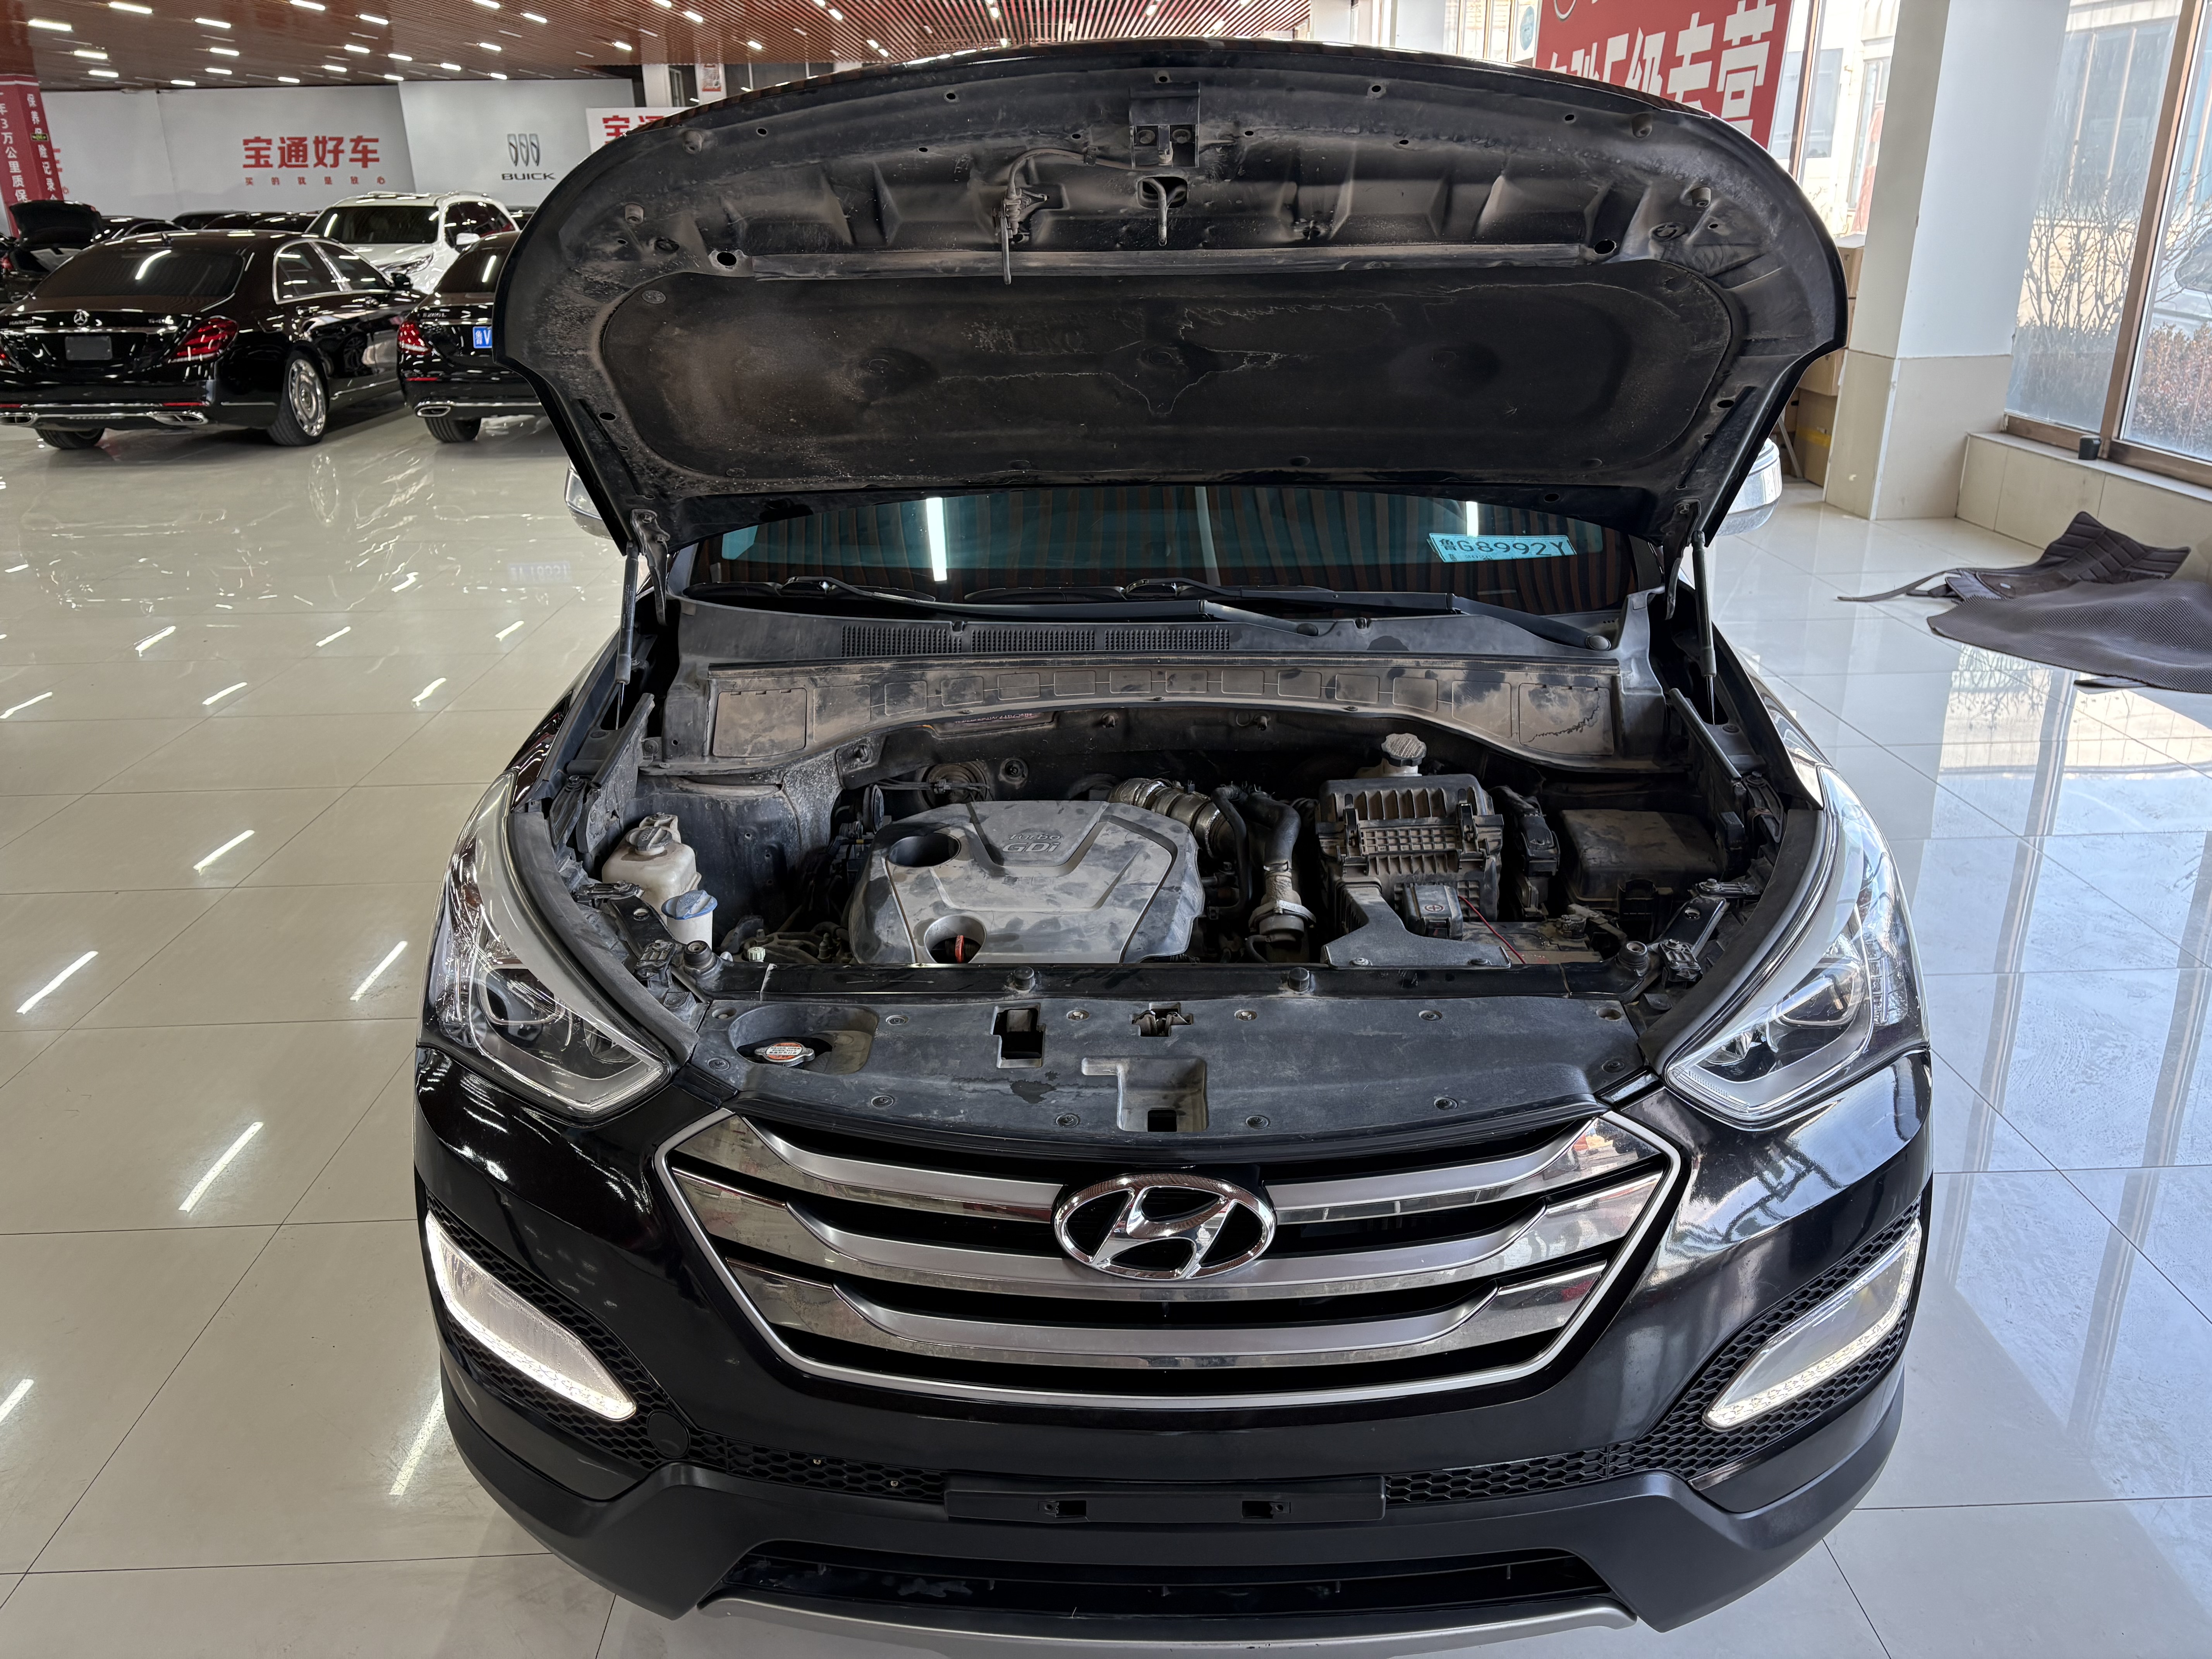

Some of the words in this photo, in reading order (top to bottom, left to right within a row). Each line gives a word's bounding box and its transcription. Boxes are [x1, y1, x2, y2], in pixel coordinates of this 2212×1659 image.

[242, 135, 380, 169] 宝通好车
[1439, 538, 1566, 556] 鲁G8992Y
[1002, 842, 1061, 852] GDi
